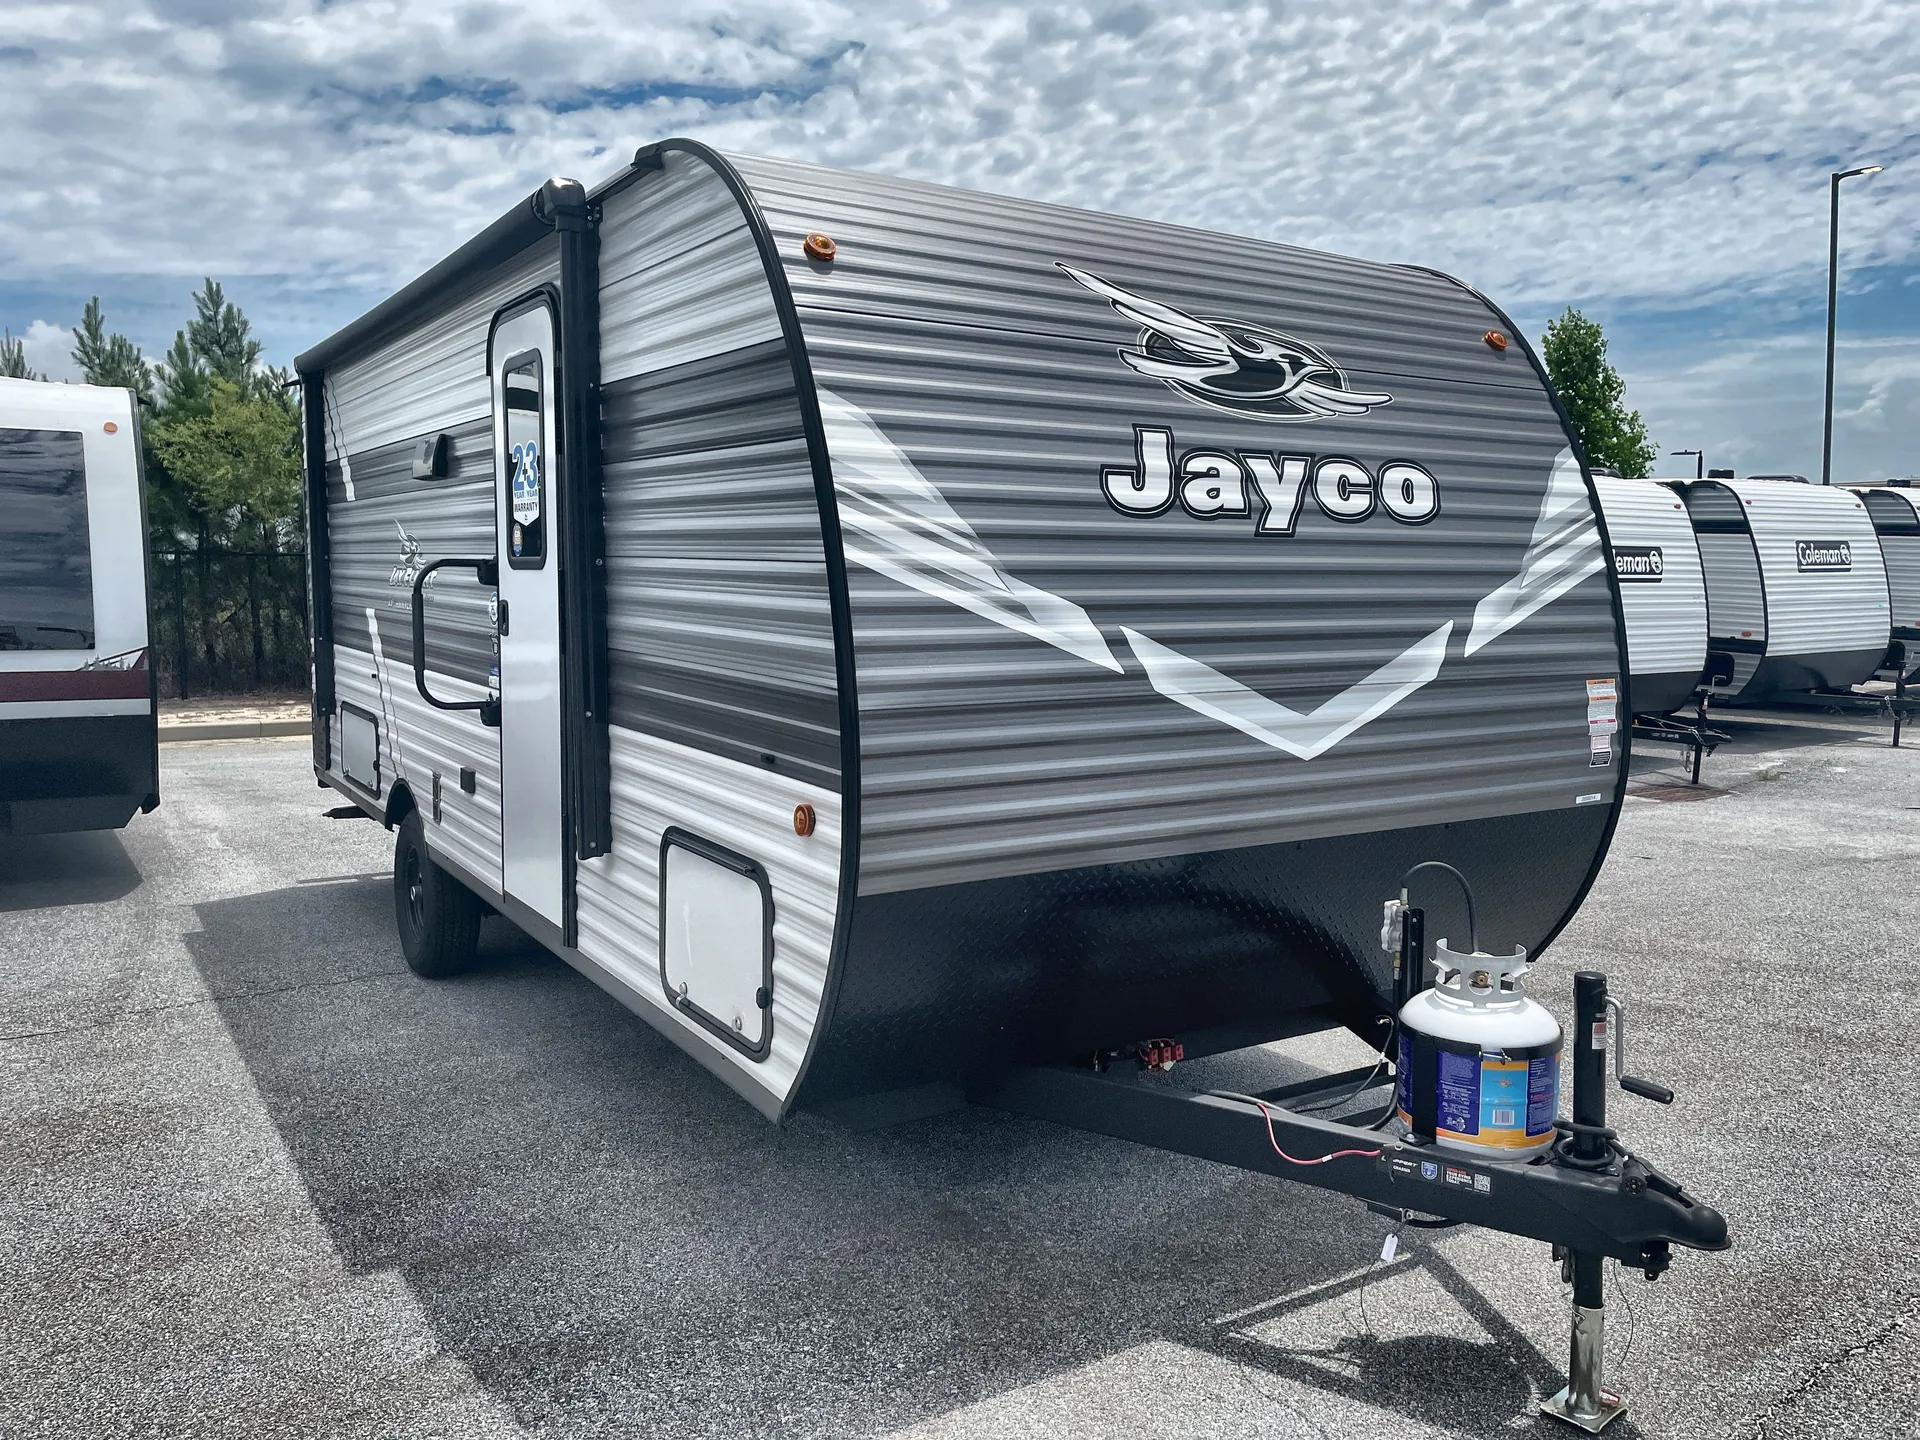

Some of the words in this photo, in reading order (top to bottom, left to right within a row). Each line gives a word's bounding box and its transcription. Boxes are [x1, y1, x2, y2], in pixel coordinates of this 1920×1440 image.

[1101, 424, 1440, 537] Jayco
[514, 491, 525, 499] YEAR
[526, 489, 538, 498] YEAR
[514, 502, 538, 513] WARRANTY
[1612, 548, 1650, 573] leman
[1798, 542, 1841, 565] Coleman
